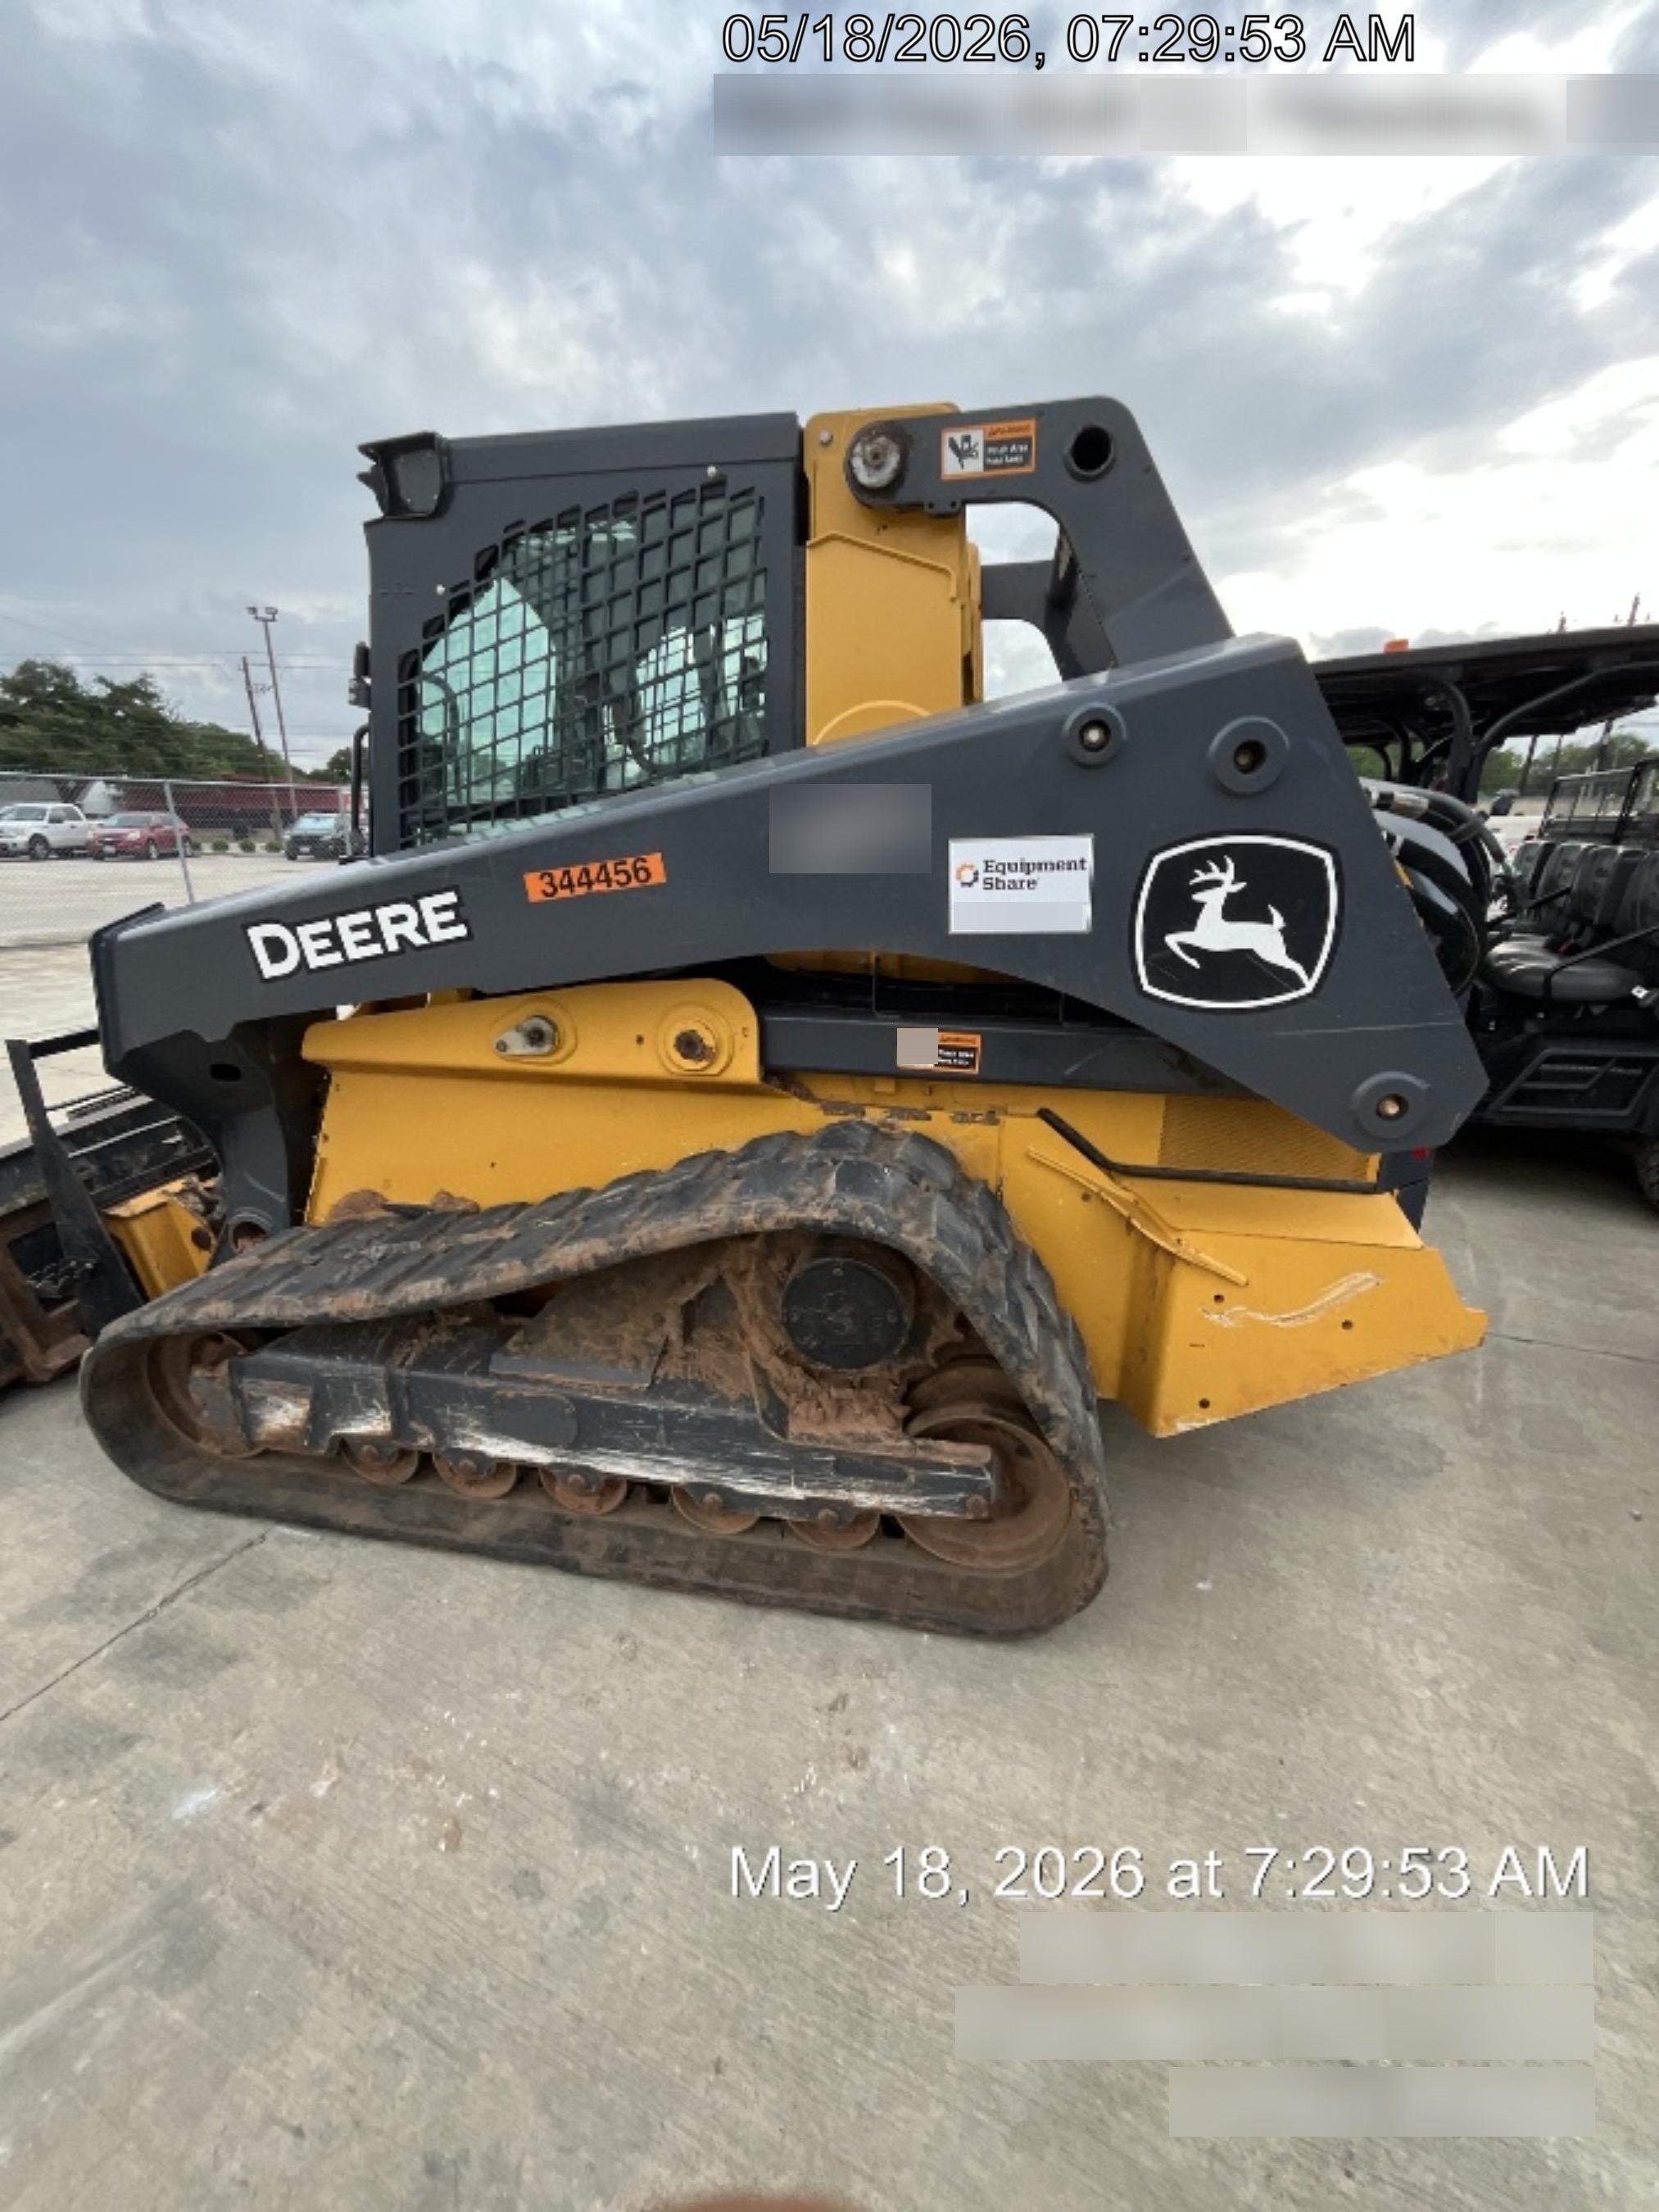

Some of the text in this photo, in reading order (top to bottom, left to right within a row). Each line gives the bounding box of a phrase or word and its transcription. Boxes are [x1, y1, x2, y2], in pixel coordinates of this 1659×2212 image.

[539, 857, 652, 897] 344456
[982, 857, 1087, 876] Equipment
[982, 877, 1038, 891] Share
[247, 891, 469, 980] DEERE
